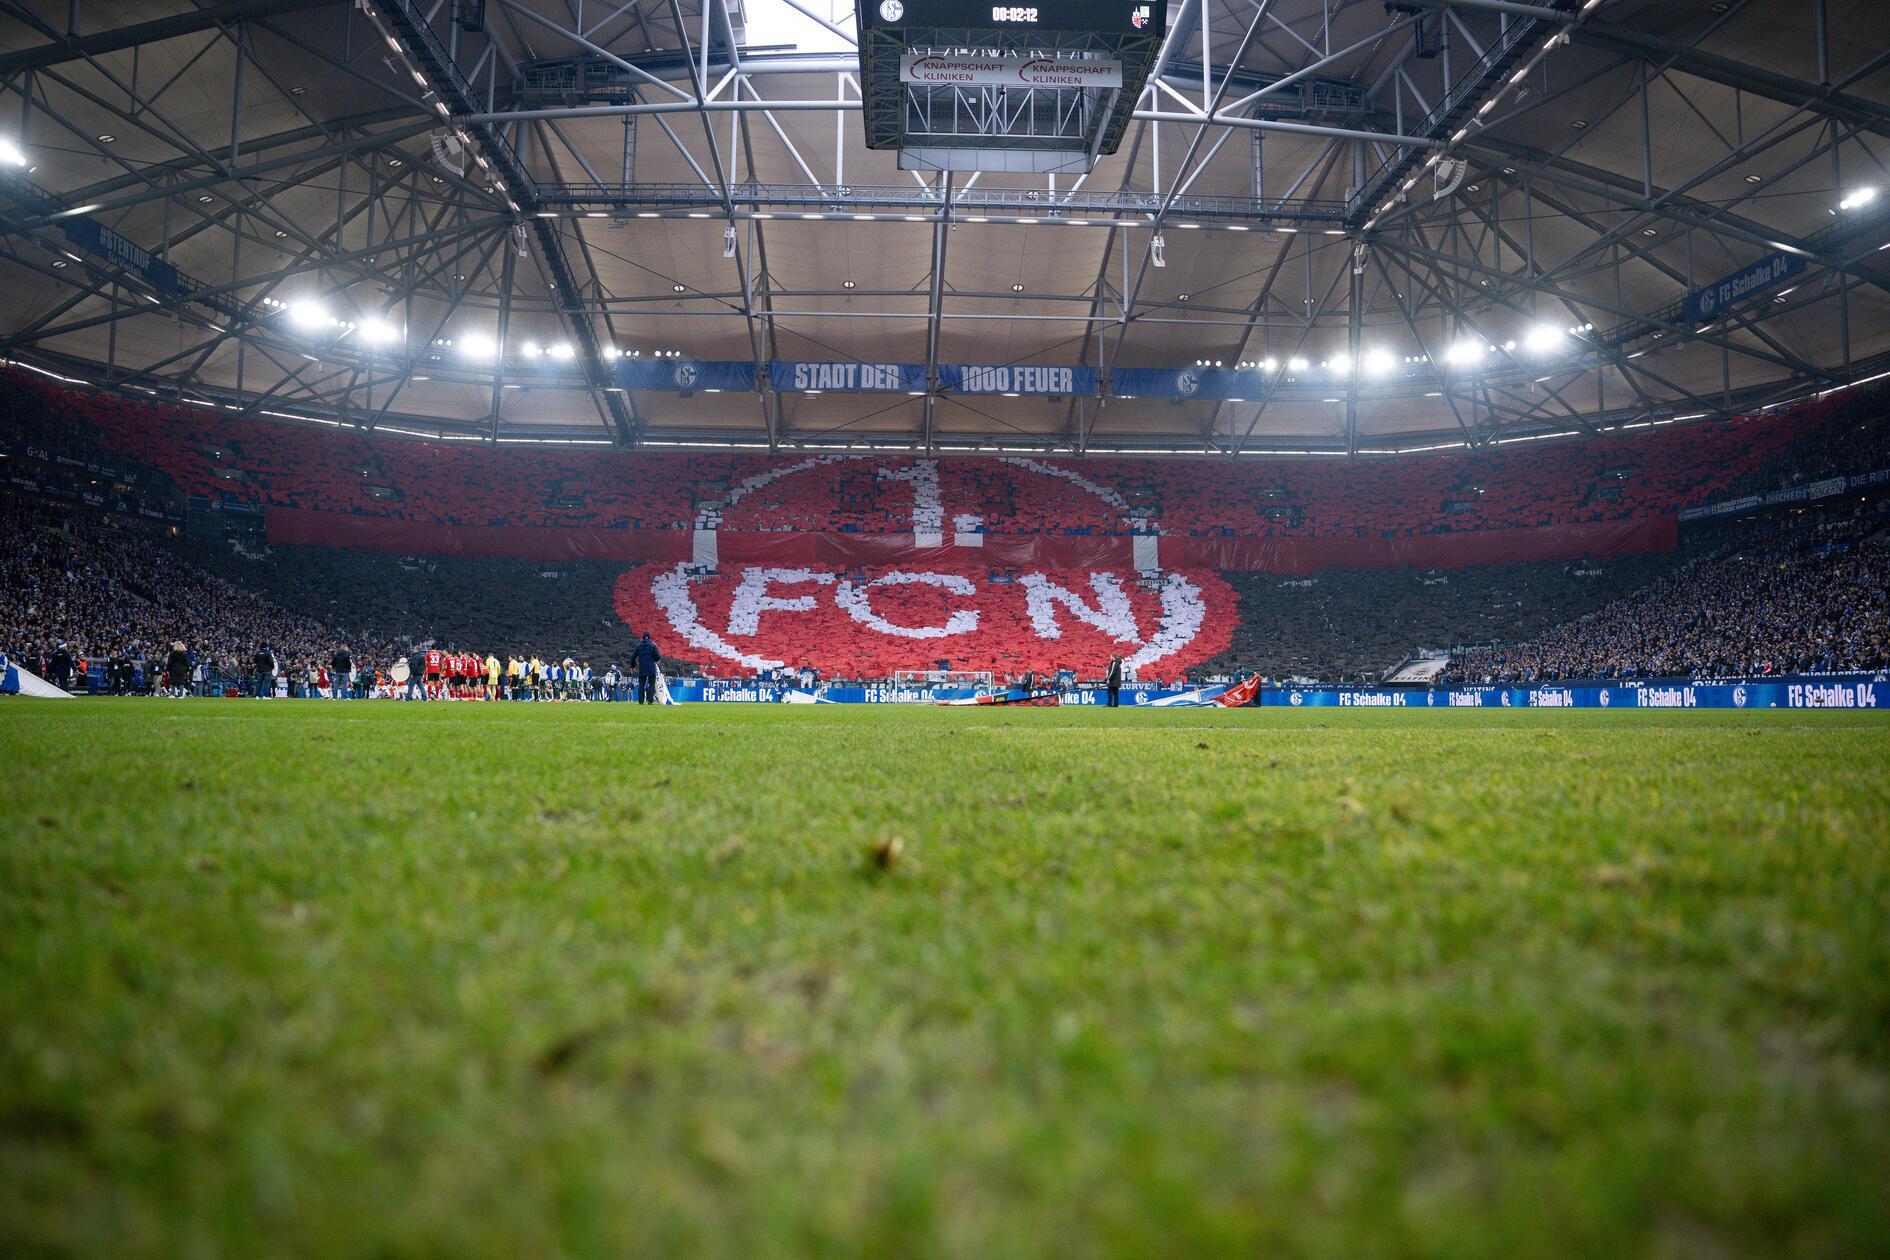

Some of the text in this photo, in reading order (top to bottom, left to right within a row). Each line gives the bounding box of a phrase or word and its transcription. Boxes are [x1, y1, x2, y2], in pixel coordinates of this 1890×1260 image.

[993, 7, 1038, 22] 00:02:12
[924, 62, 1005, 72] KNAPPSCHAFT
[1032, 65, 1113, 75] KNAPPSCHAFT
[924, 72, 973, 81] KLINIKEN
[1032, 75, 1082, 84] KLINIKEN
[1719, 255, 1788, 304] FC Schalke 04
[795, 363, 899, 389] STADT DER
[961, 366, 1073, 392] 1000 FEUER
[703, 688, 716, 701] FC
[759, 688, 773, 701] 04
[865, 689, 878, 702] FC
[1081, 691, 1095, 704] 04
[1339, 692, 1406, 706] FC Schalke 04
[1449, 692, 1482, 706] FC Schalke 04
[1538, 690, 1562, 706] Schalke
[1563, 690, 1573, 706] 04
[1637, 687, 1696, 707] FC Schalke 04
[1788, 683, 1876, 708] FC Schalke 04
